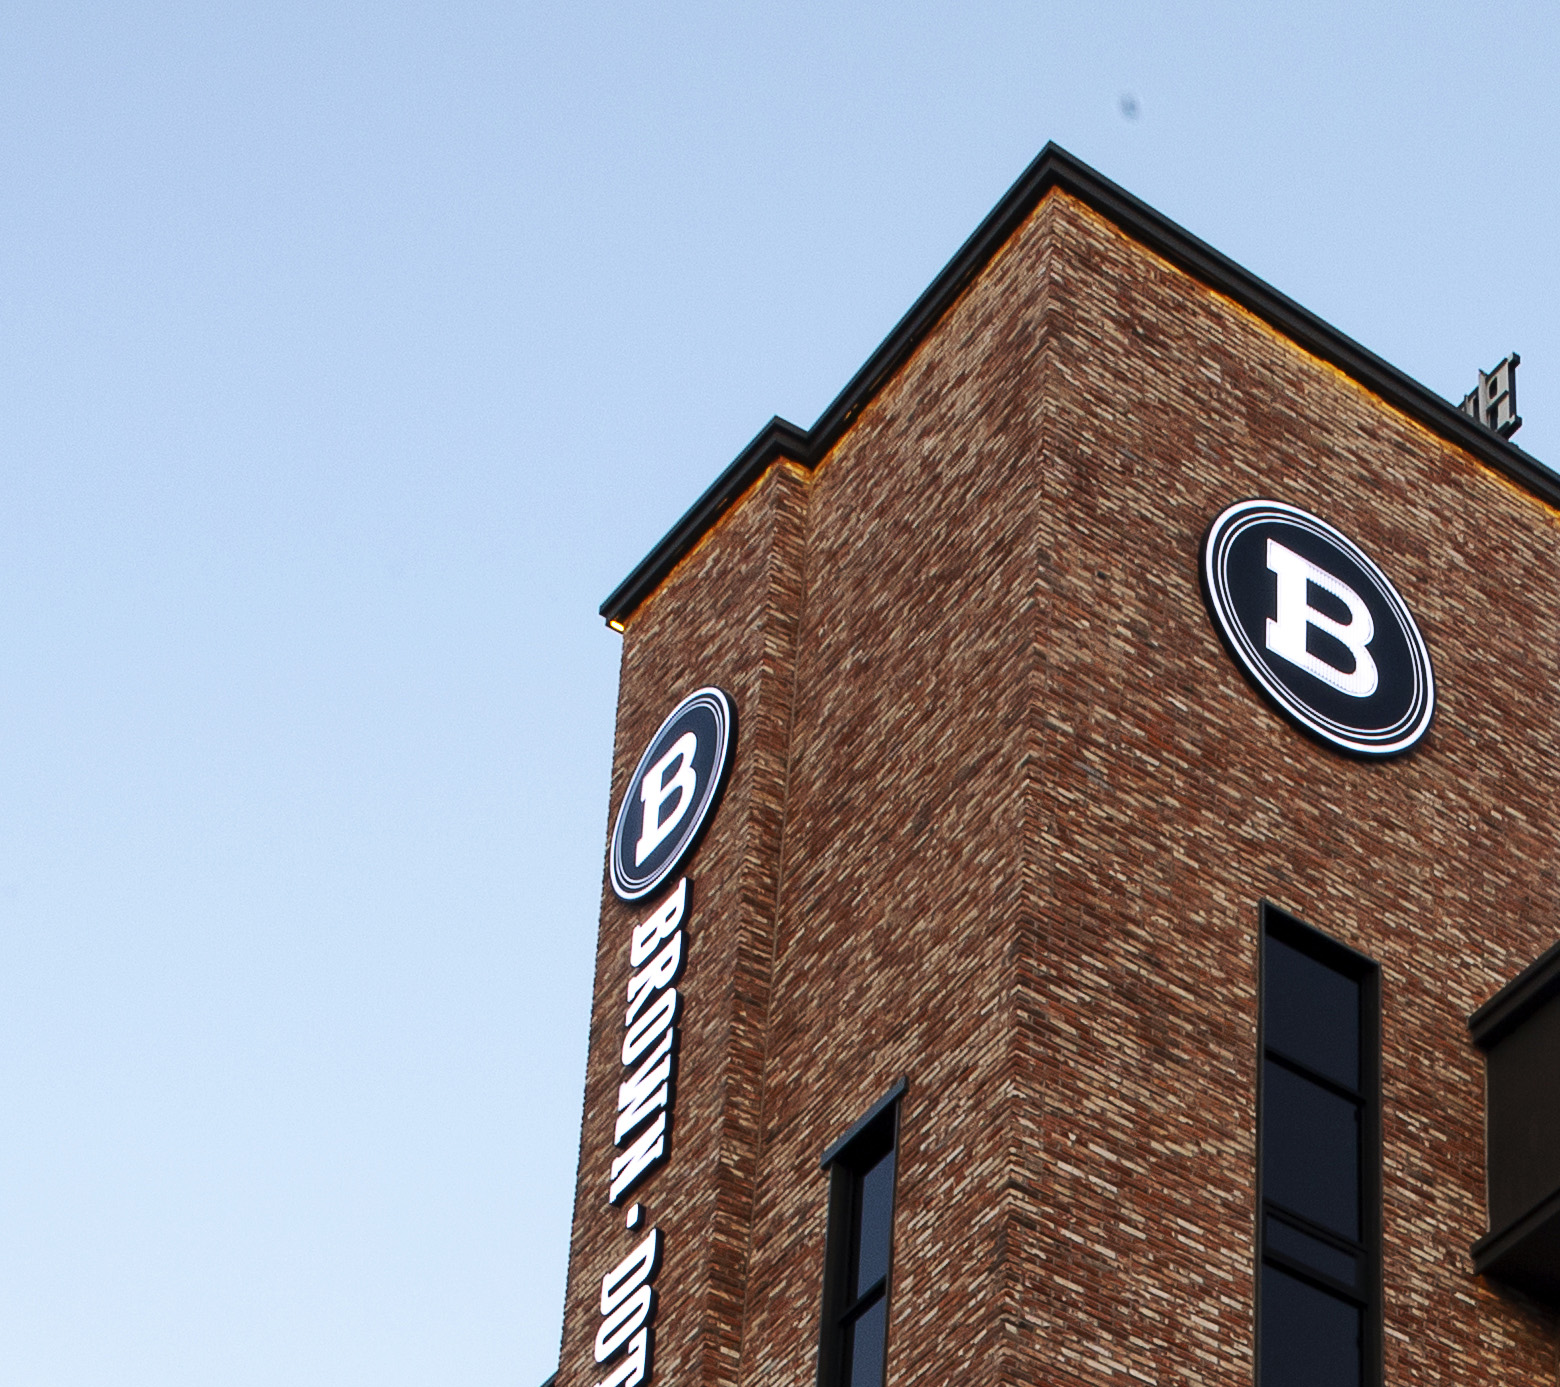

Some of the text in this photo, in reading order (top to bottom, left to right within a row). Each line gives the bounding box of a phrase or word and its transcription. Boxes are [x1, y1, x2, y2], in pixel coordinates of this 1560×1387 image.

[1266, 537, 1379, 698] B
[636, 730, 698, 868] B
[609, 877, 688, 1203] BROWN
